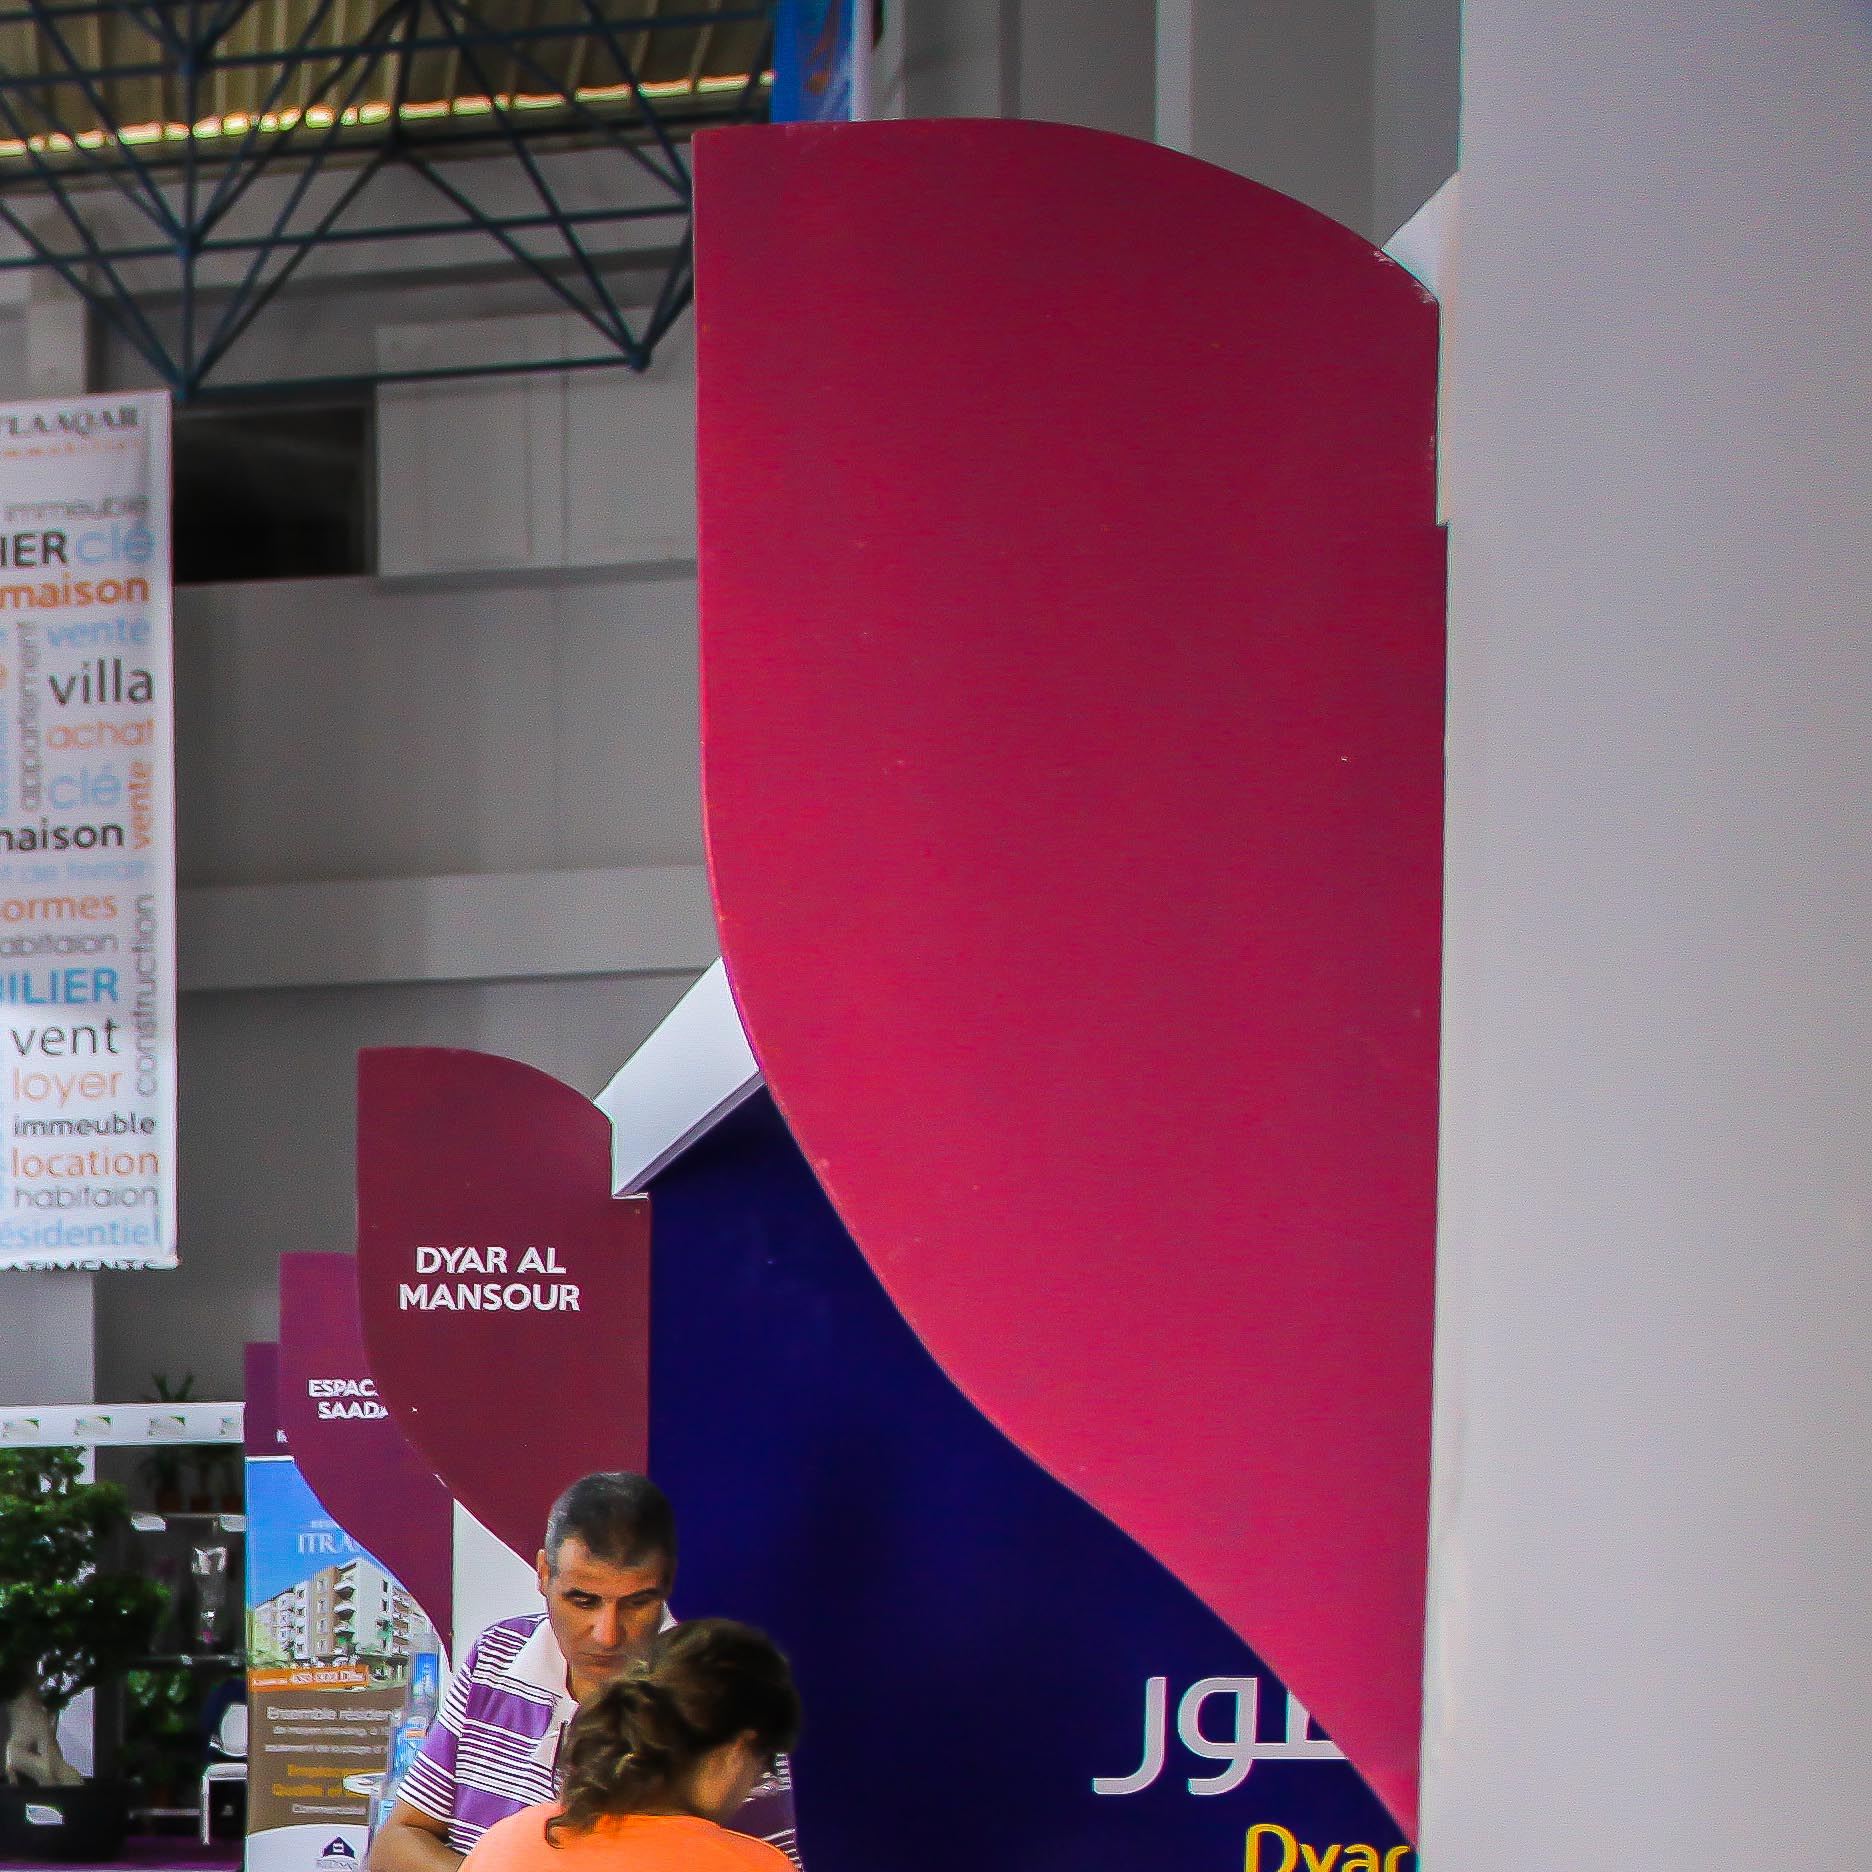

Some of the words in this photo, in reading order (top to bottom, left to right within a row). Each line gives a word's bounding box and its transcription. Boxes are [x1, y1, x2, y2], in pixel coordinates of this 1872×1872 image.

[48, 656, 155, 706] villa
[45, 717, 155, 752] achat
[127, 759, 153, 851] vente
[10, 1016, 123, 1057] vent
[12, 1066, 124, 1106] loyer
[13, 1111, 155, 1138] immeuble
[11, 1146, 159, 1179] location
[416, 1246, 508, 1275] DYAR
[517, 1246, 568, 1275] AL
[398, 1283, 582, 1312] MANSOUR
[308, 1379, 379, 1397] ESPAC
[298, 1532, 359, 1554] ITRA
